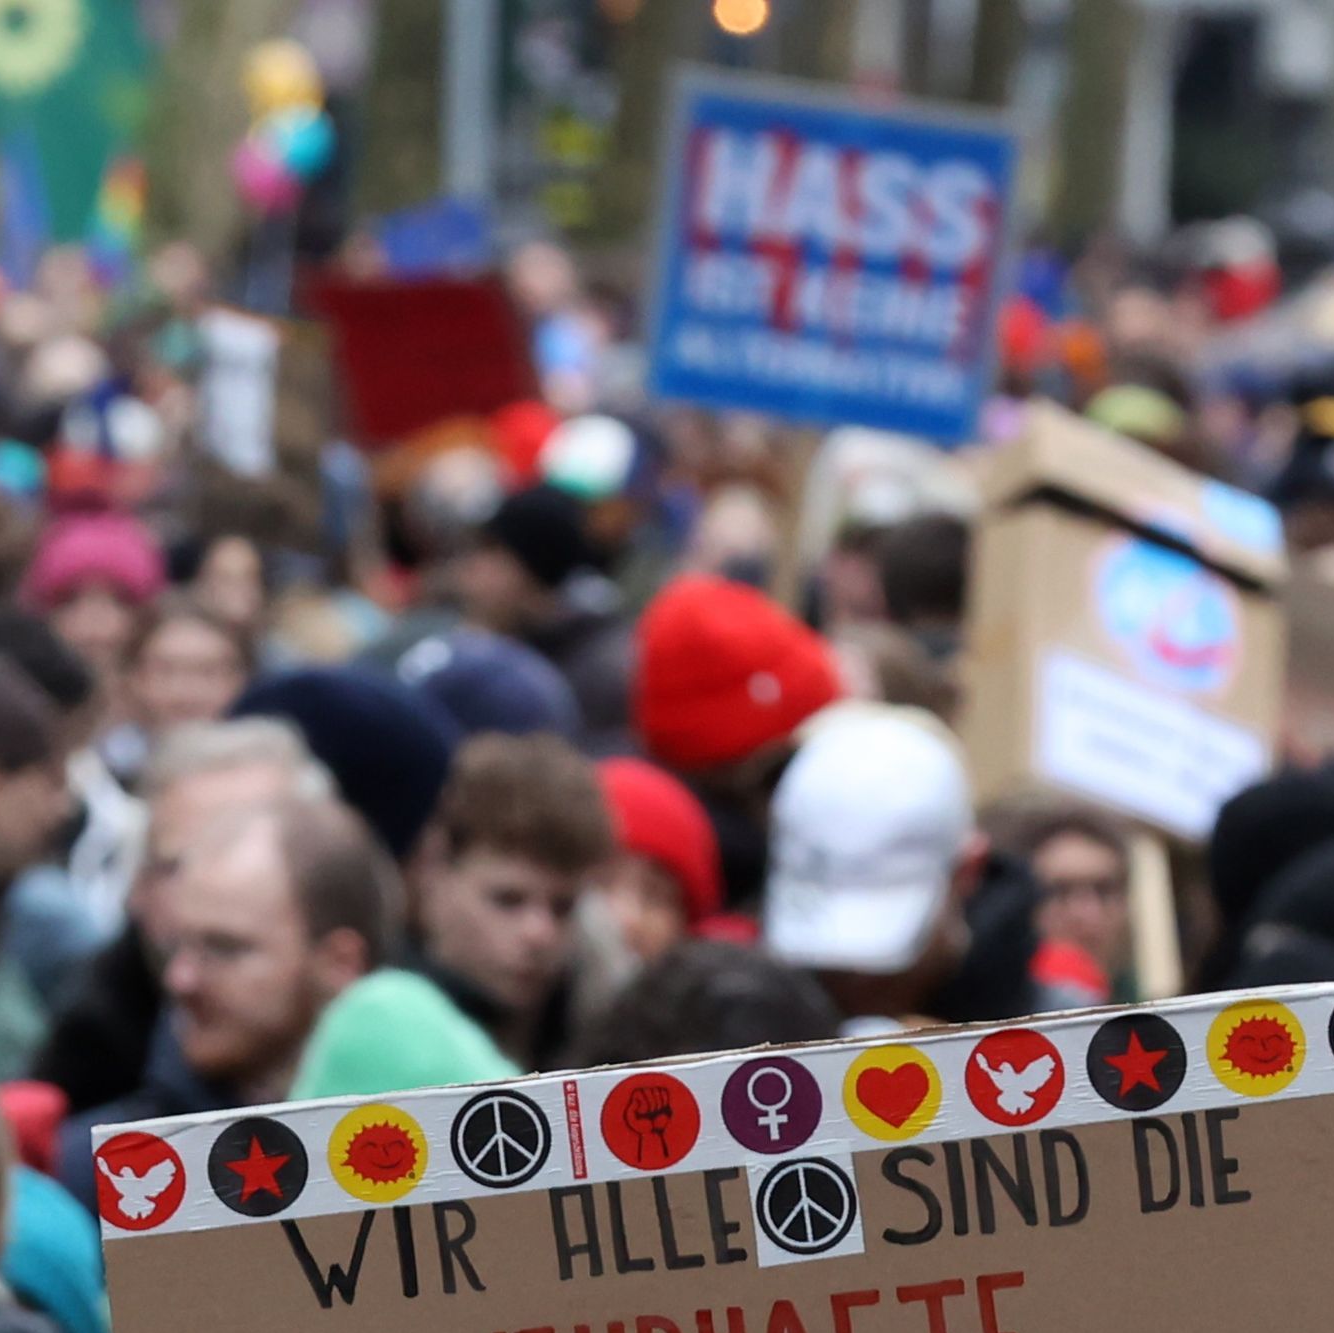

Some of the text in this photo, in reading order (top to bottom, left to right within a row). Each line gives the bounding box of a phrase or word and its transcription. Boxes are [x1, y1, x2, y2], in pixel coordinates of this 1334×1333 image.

[699, 126, 995, 270] HASS
[278, 1107, 1253, 1309] WIR ALLE SIND DIE
